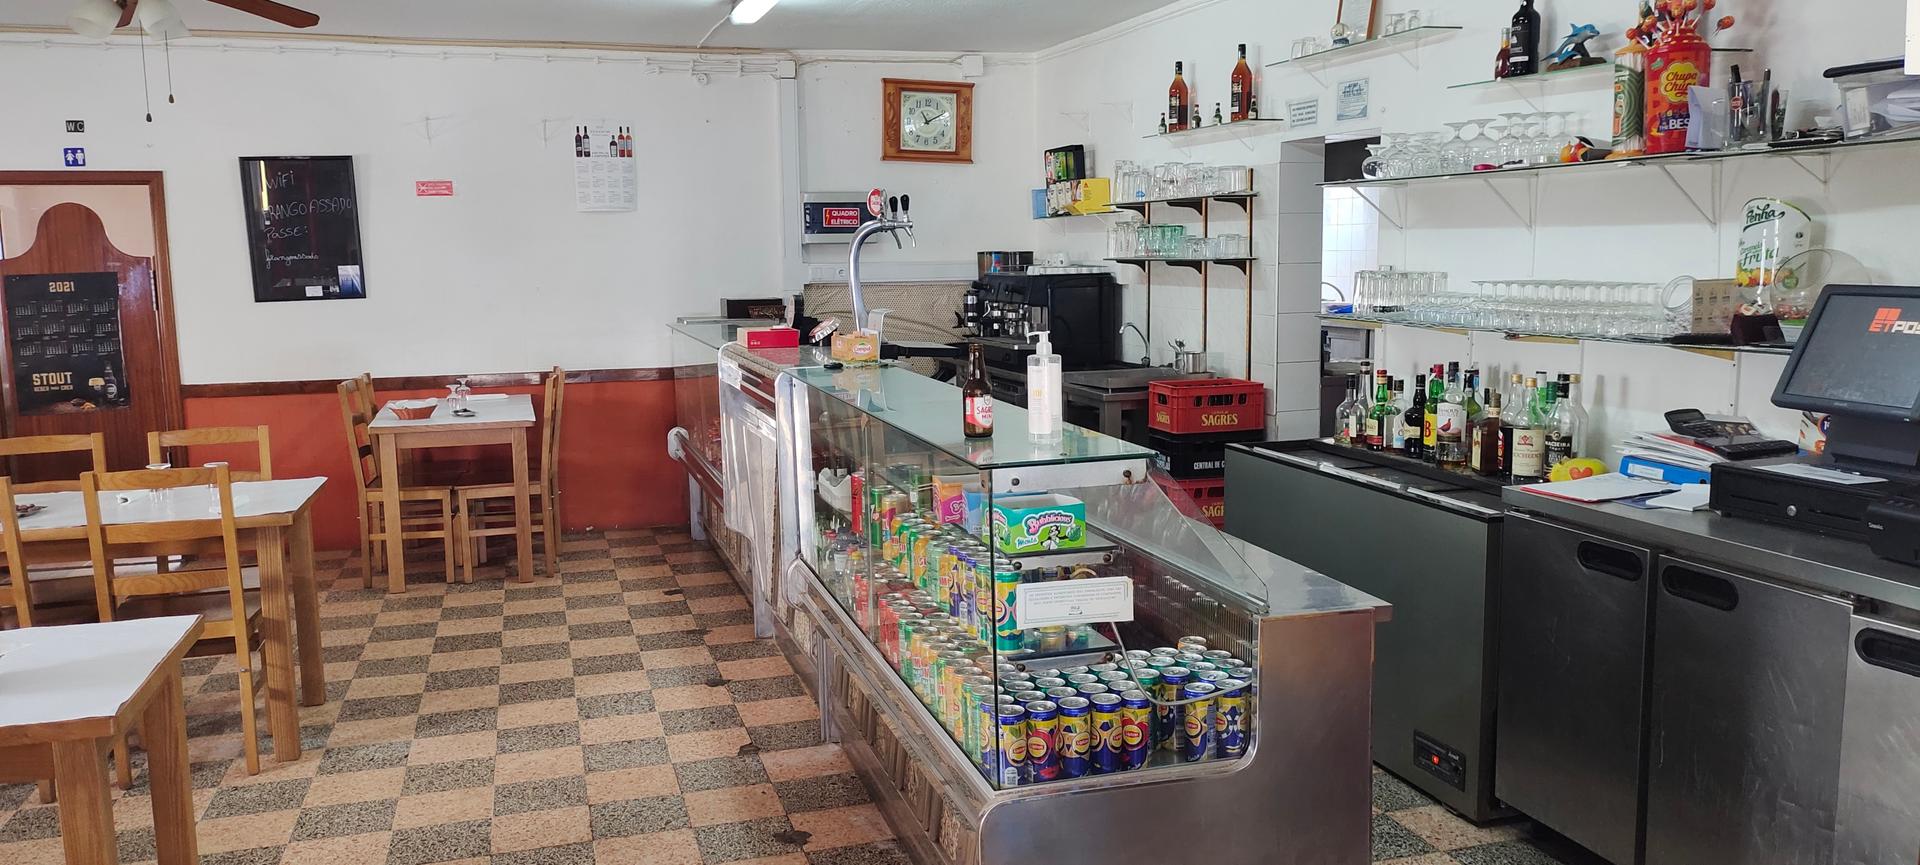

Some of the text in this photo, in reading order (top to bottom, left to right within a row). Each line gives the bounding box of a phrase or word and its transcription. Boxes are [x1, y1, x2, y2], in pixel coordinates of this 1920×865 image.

[1666, 71, 1698, 84] Chupa
[66, 121, 84, 131] WC
[1669, 118, 1690, 130] BES
[1746, 203, 1785, 224] Penha
[49, 281, 74, 292] 2021
[32, 371, 72, 386] STOUT
[1201, 413, 1238, 427] SAGRES
[1194, 461, 1213, 470] CENTRAL
[1027, 512, 1073, 535] Bubblicious
